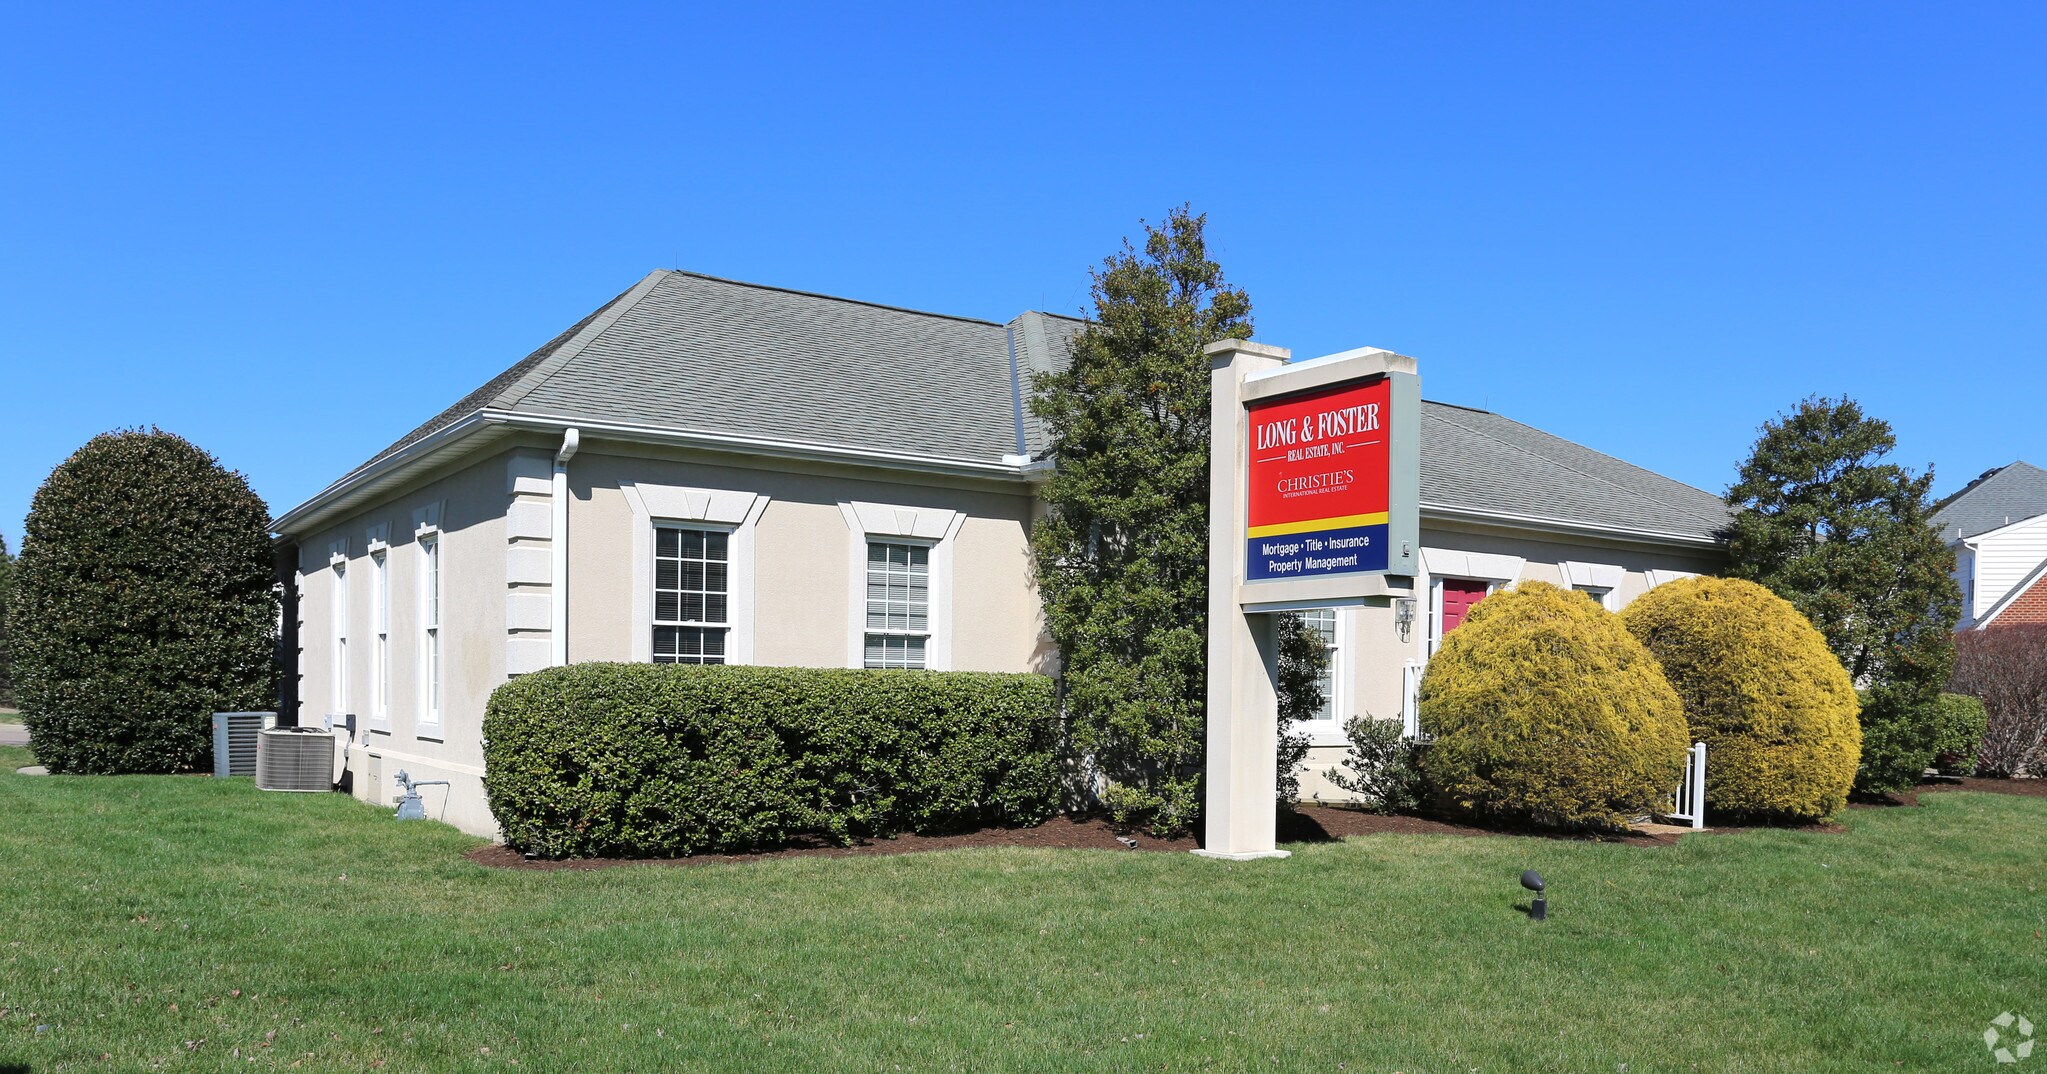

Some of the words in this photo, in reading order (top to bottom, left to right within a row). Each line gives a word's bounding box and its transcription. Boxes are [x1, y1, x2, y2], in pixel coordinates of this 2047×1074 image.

[1257, 418, 1296, 450] LONG
[1300, 416, 1314, 442] &
[1317, 403, 1379, 440] FOSTER
[1287, 447, 1304, 462] REAL
[1305, 444, 1331, 459] ESTATE,
[1331, 442, 1345, 455] INC.
[1277, 469, 1354, 493] CHRISTIE'S
[1282, 489, 1318, 499] INTERNATIONAL
[1318, 487, 1331, 495] REAL
[1331, 485, 1348, 493] ESTATE
[1262, 542, 1299, 557] Mortgage
[1305, 538, 1323, 552] Title
[1329, 535, 1370, 550] Insurance
[1269, 559, 1302, 574] Property
[1305, 554, 1358, 571] Management
